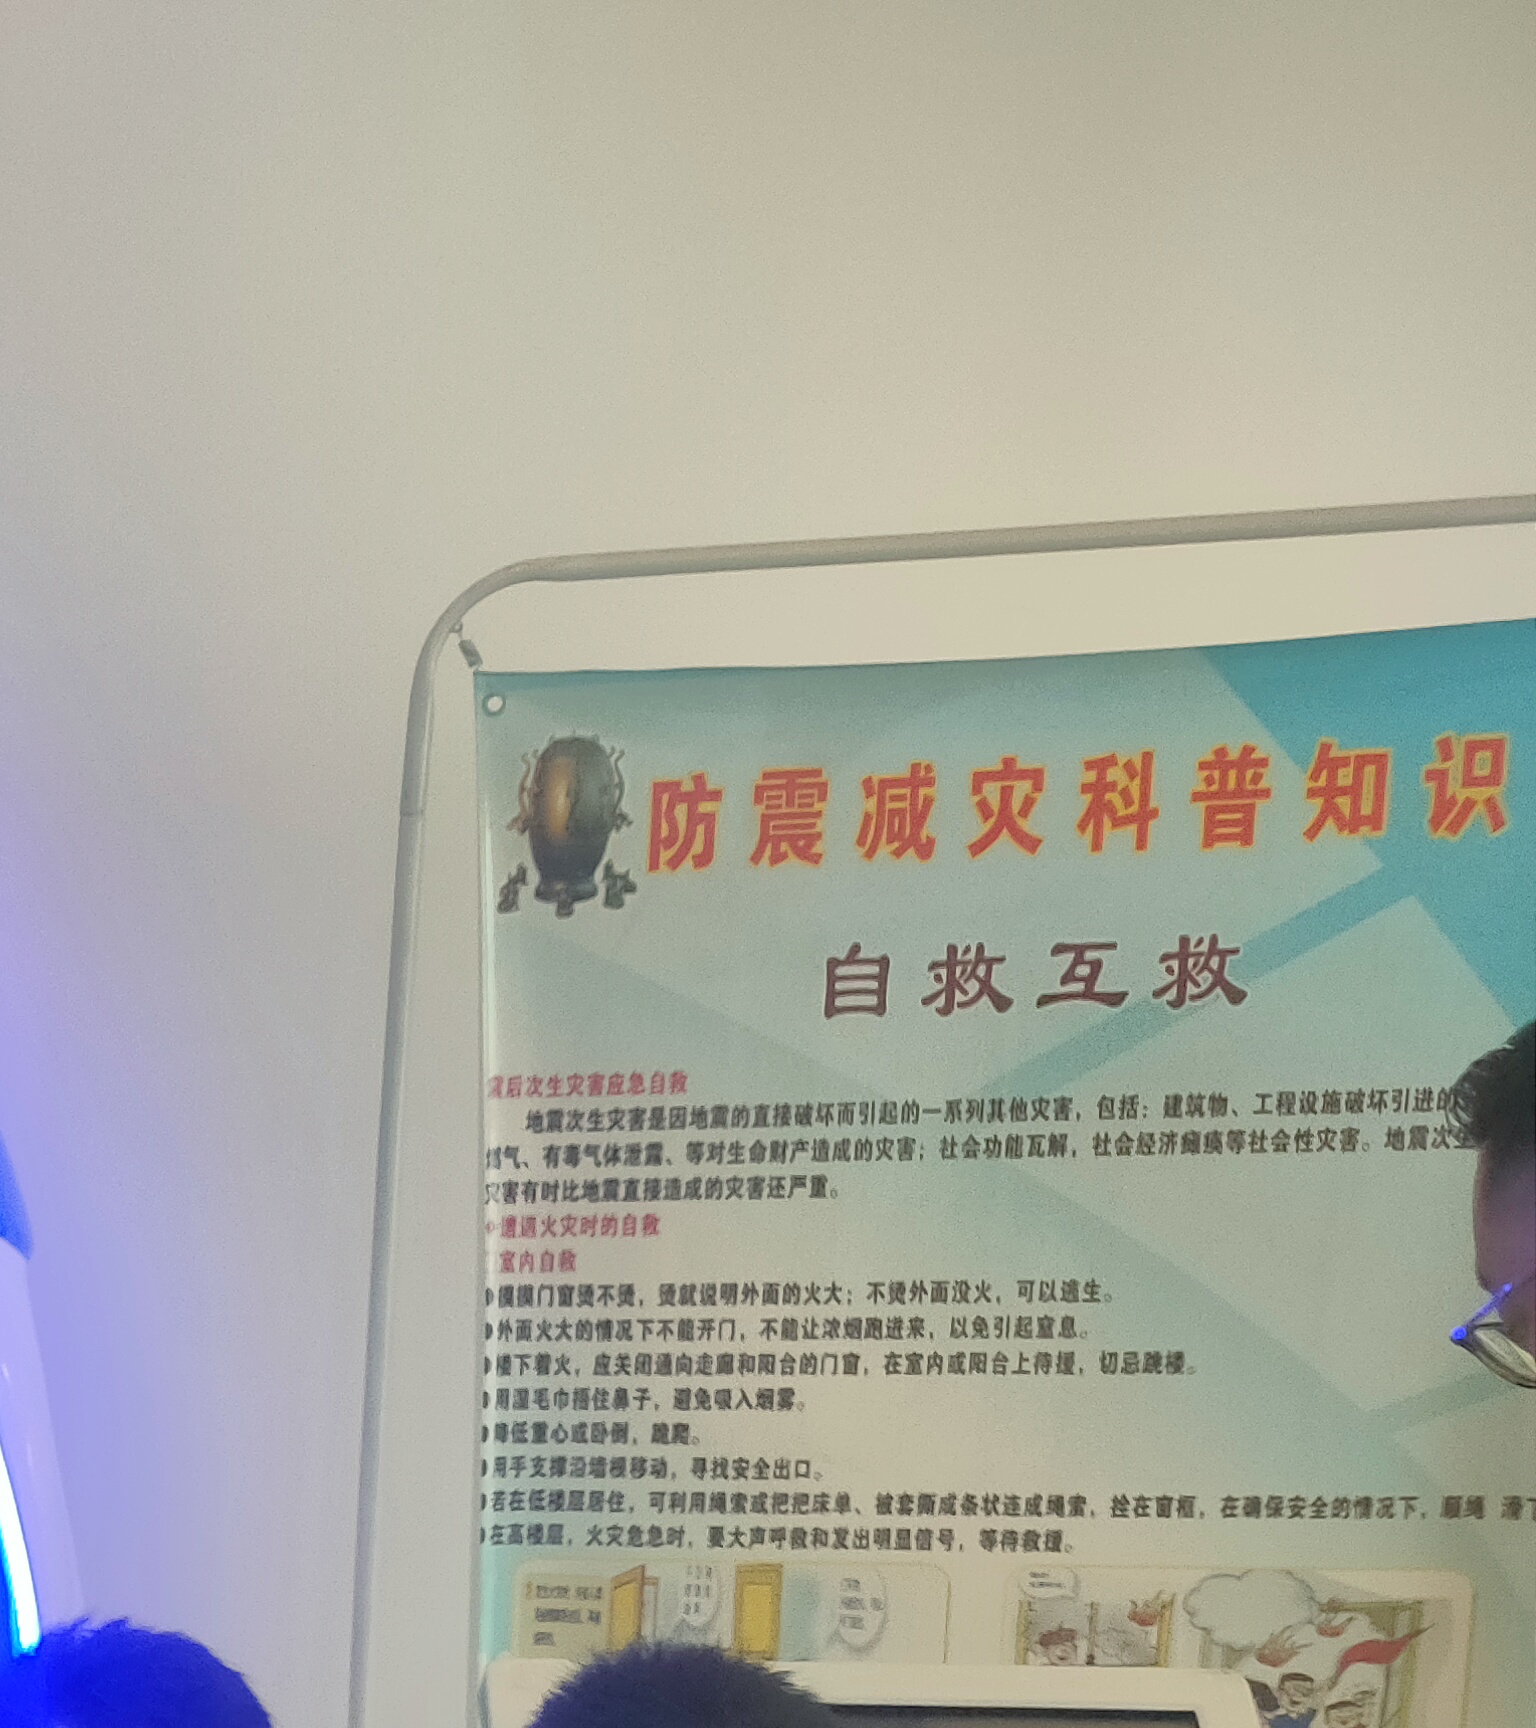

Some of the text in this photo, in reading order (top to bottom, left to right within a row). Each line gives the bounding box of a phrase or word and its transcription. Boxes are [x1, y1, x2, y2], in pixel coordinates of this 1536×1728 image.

[645, 731, 1511, 873] 防震减灾科普知识
[823, 933, 1249, 1020] 自救互救
[499, 1249, 577, 1273] 室内自救
